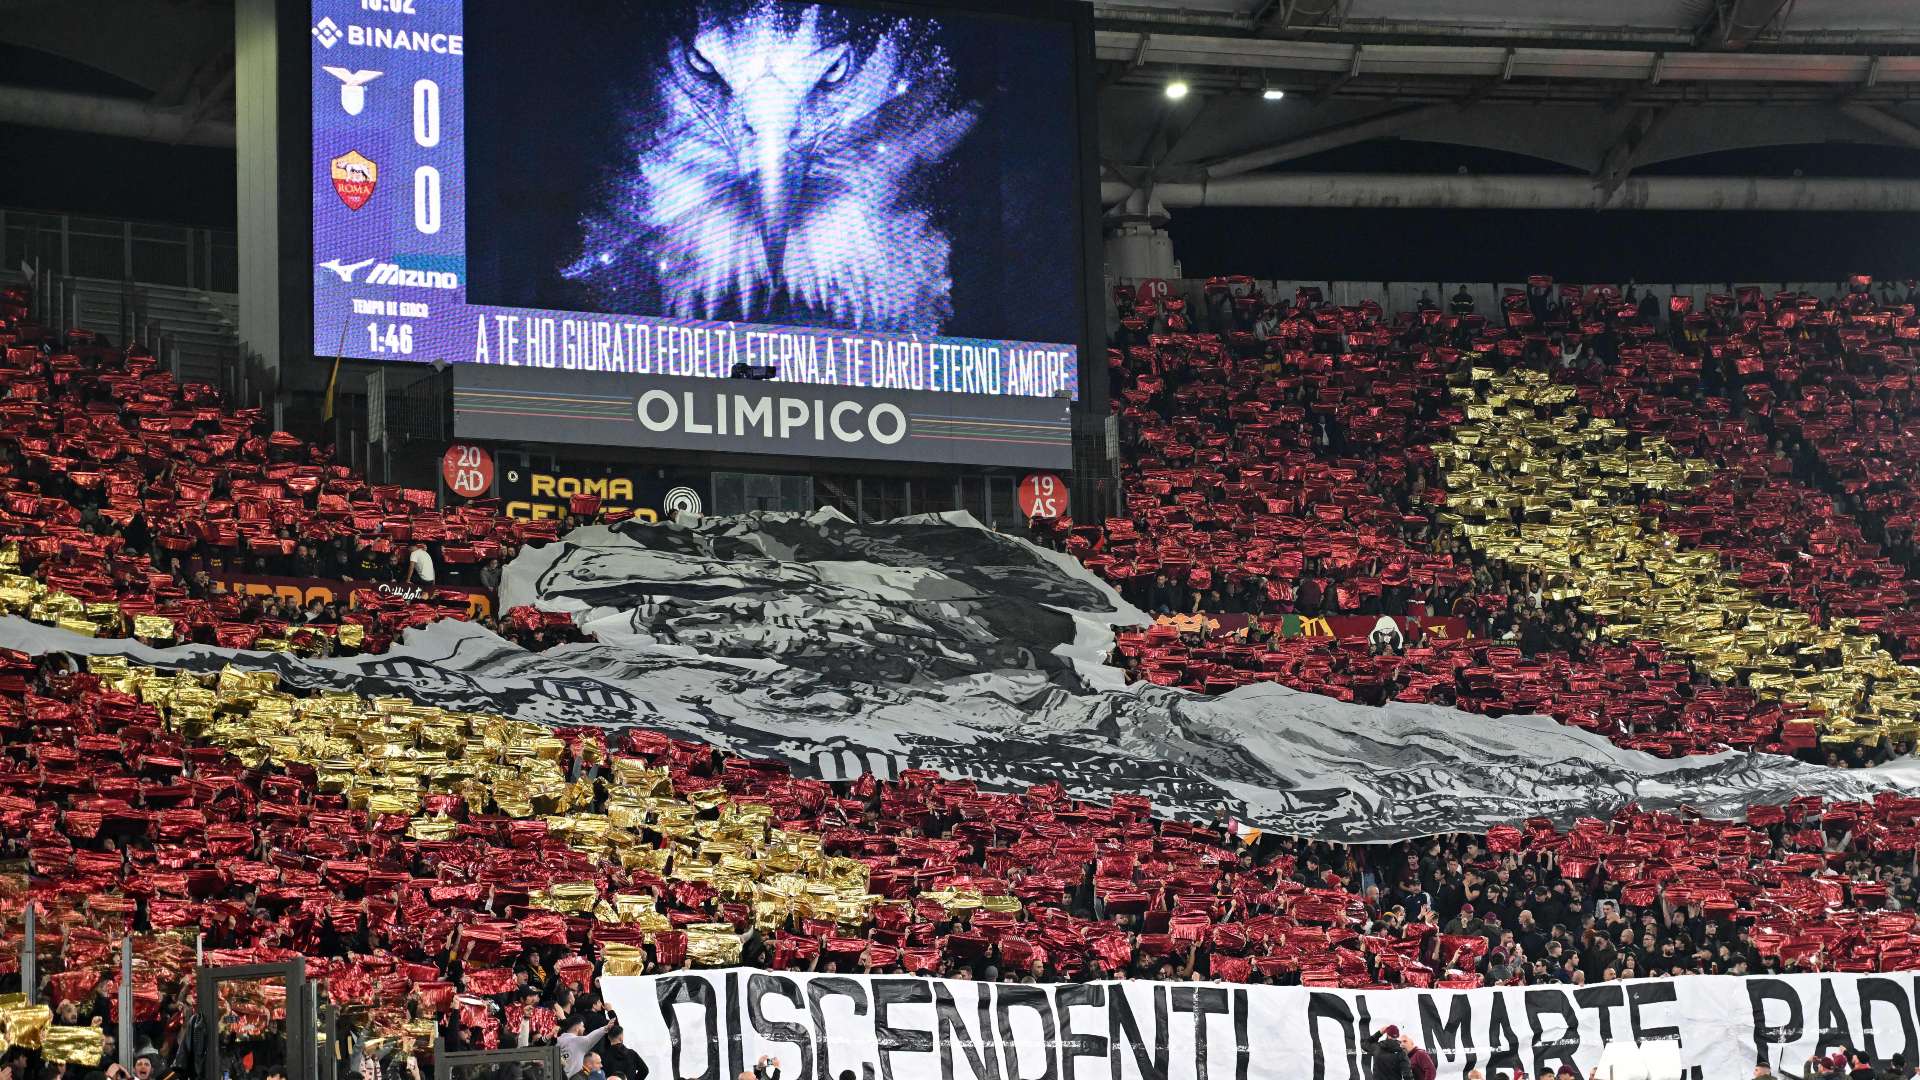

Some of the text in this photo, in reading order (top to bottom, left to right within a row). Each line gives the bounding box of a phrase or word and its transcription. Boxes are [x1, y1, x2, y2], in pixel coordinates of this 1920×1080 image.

[347, 25, 463, 55] BINANCE
[413, 79, 440, 148] 0
[338, 183, 371, 195] ROMA
[414, 165, 441, 234] 0
[1148, 281, 1168, 298] 19
[367, 322, 413, 354] 1:46
[475, 313, 490, 364] A
[495, 315, 520, 366] TE
[526, 318, 556, 369] HO
[562, 320, 650, 374] GIURATO
[657, 320, 739, 378] FEDELTÀ
[842, 337, 865, 387] TE
[871, 333, 924, 391] DARÒ
[929, 343, 1001, 395] ETERNO
[1007, 349, 1069, 398] AMORE
[637, 389, 907, 445] OLIMPICO
[457, 445, 481, 467] 20
[454, 469, 484, 491] AD
[531, 473, 634, 500] ROMA
[1030, 476, 1055, 497] 19
[1031, 498, 1057, 519] AS
[655, 971, 1251, 1080] DISCENDENTI
[1307, 990, 1377, 1080] DI
[1746, 975, 1920, 1080] PAD
